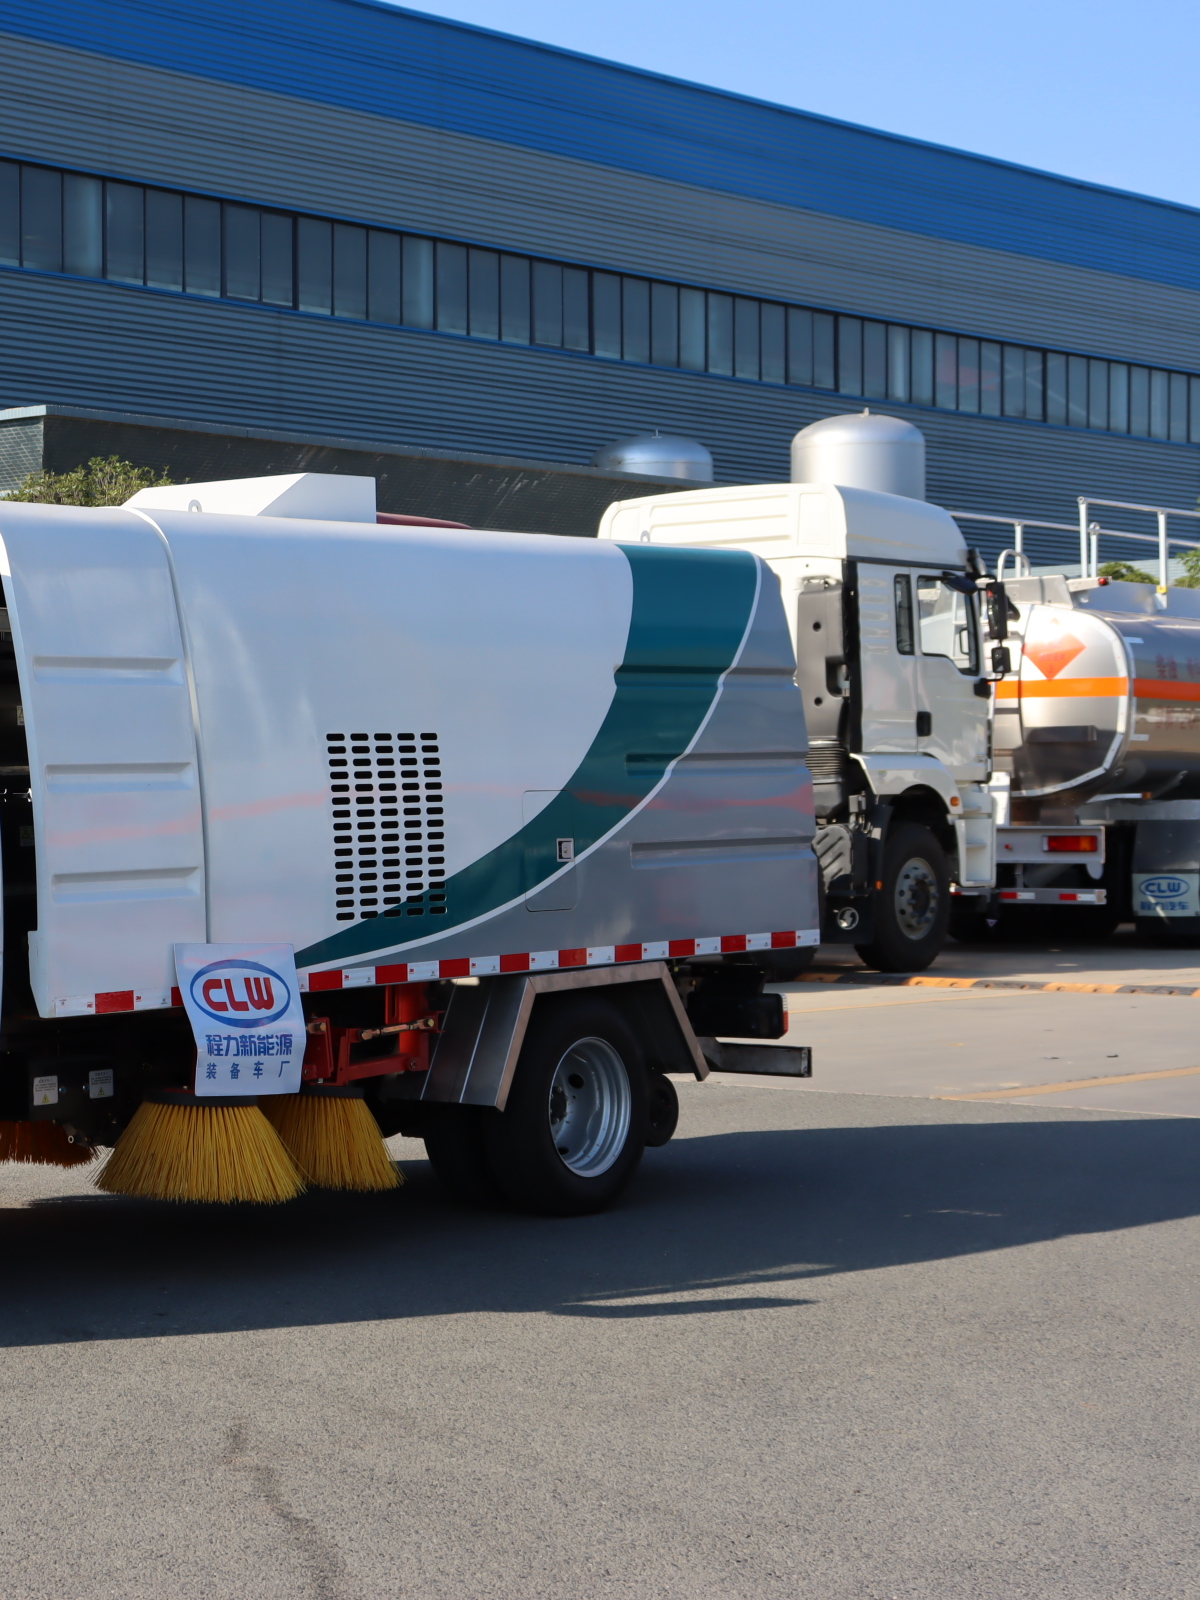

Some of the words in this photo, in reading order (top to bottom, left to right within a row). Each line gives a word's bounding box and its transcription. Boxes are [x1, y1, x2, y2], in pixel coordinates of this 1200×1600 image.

[1145, 882, 1181, 893] CLW
[202, 977, 275, 1012] CLW
[205, 1034, 293, 1057] 程力新能源
